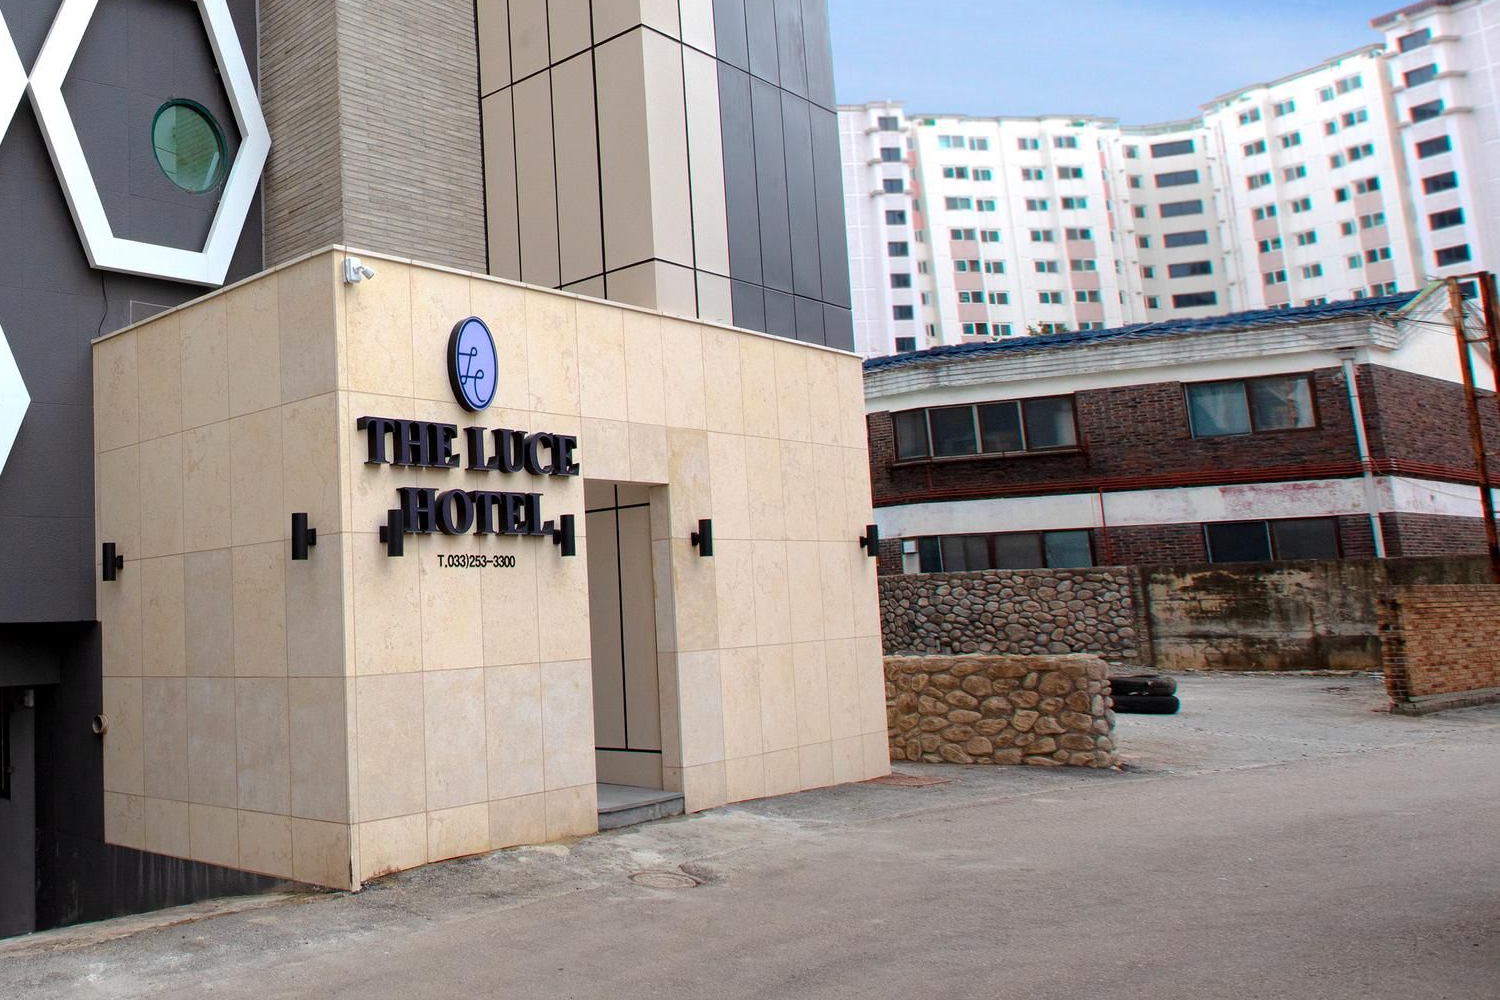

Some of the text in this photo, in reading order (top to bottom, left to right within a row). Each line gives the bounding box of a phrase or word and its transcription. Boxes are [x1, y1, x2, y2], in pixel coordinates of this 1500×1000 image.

[356, 416, 580, 477] THE LUCE
[397, 487, 555, 536] HOTEL
